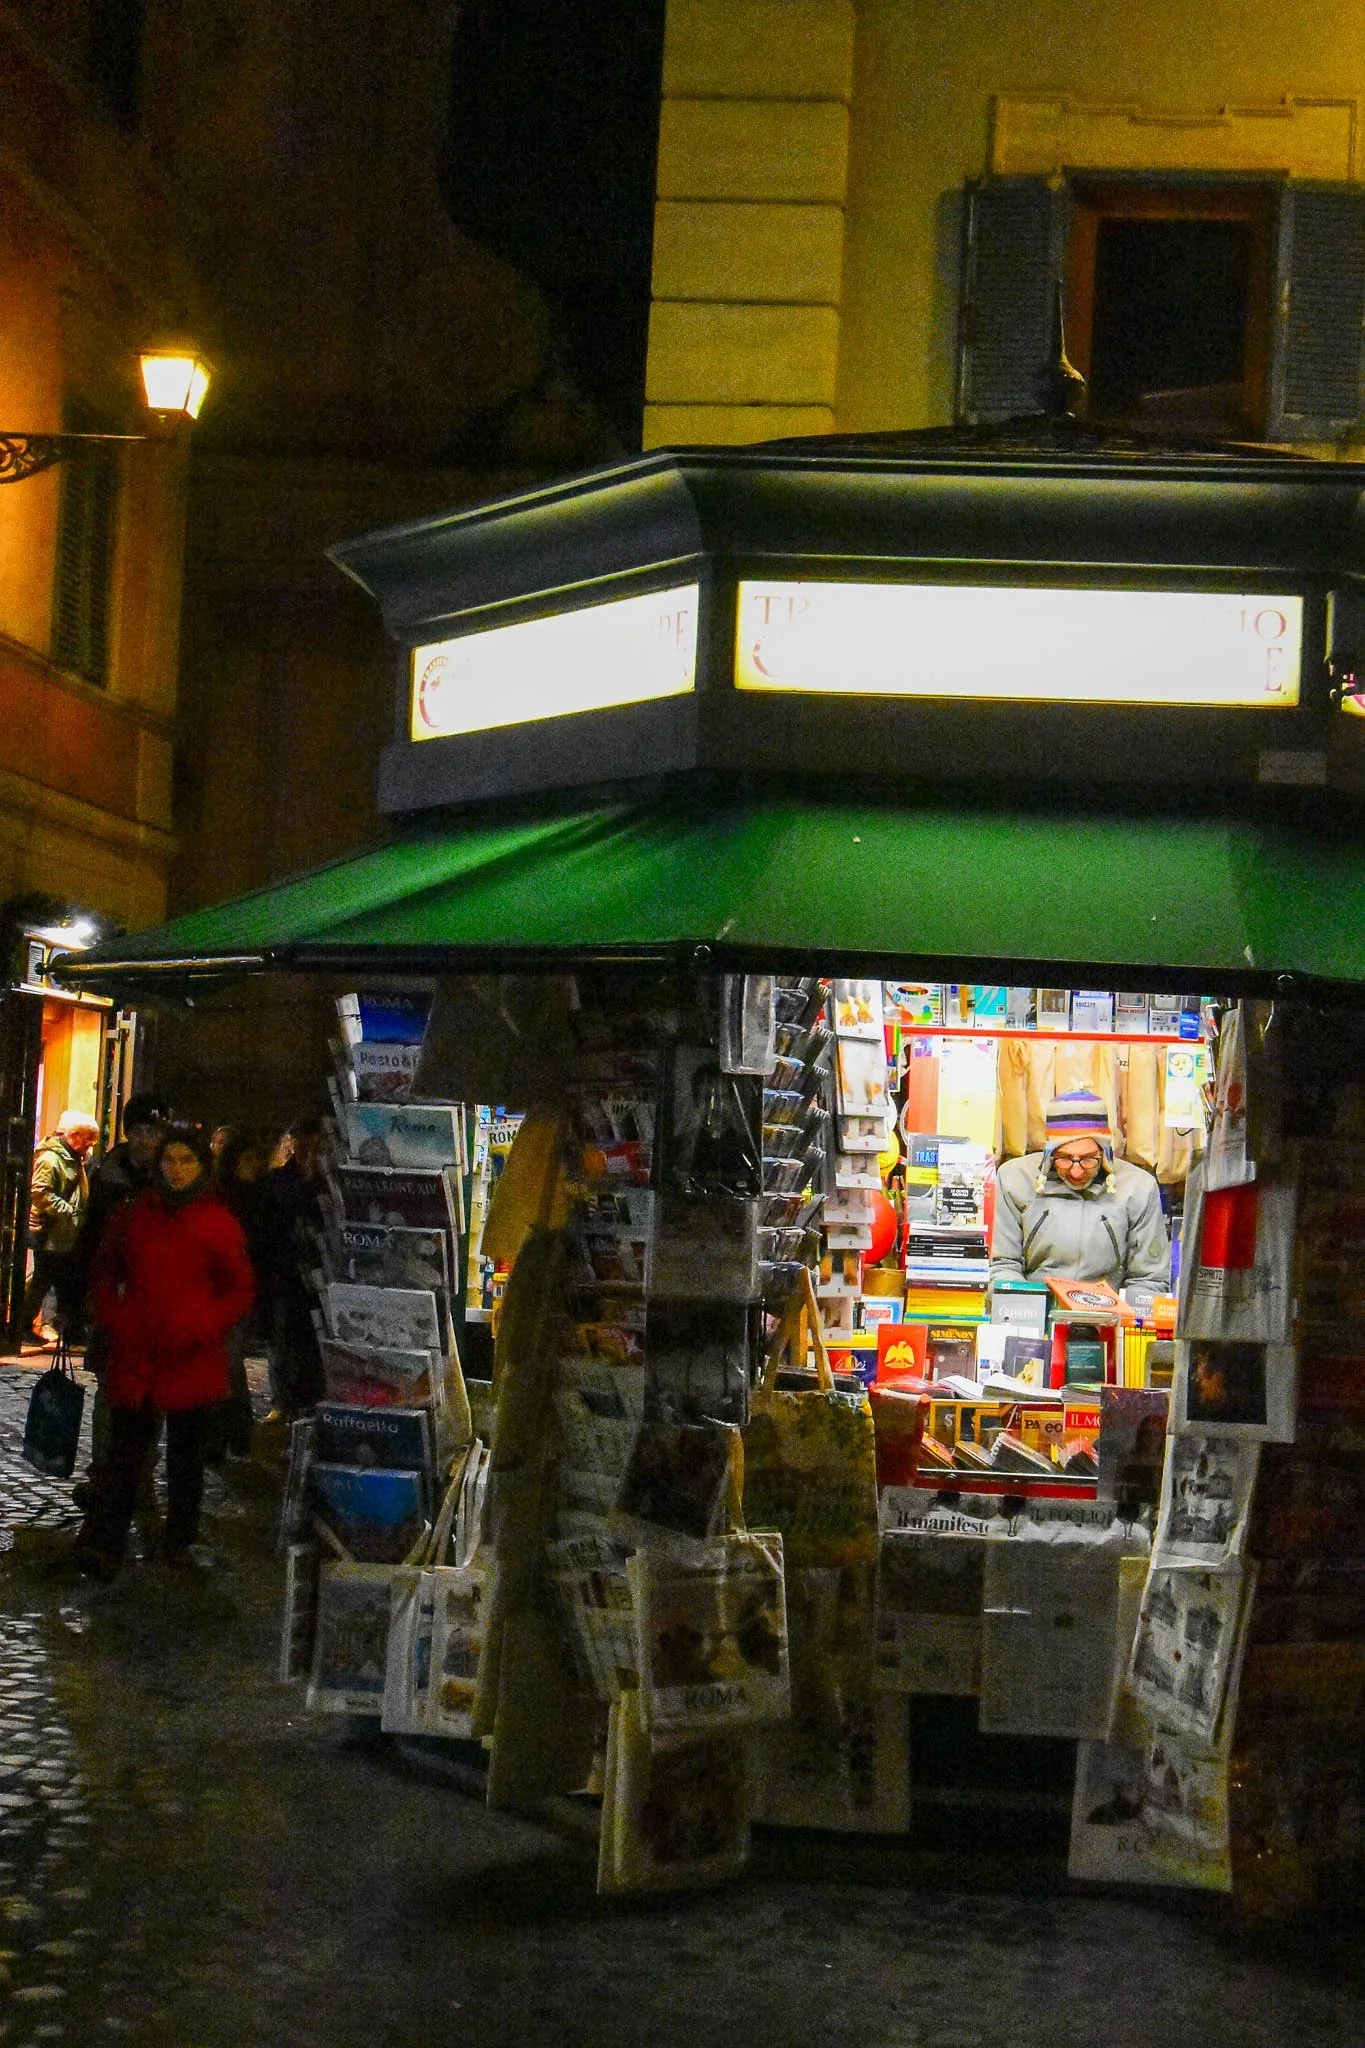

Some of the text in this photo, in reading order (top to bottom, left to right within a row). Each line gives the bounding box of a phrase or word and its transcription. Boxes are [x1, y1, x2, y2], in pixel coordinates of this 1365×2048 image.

[489, 1129, 517, 1145] ROM
[915, 1151, 938, 1163] TRAS
[343, 1231, 393, 1249] ROMA
[930, 1329, 975, 1340] SIMENON
[322, 1412, 399, 1434] Raffaello
